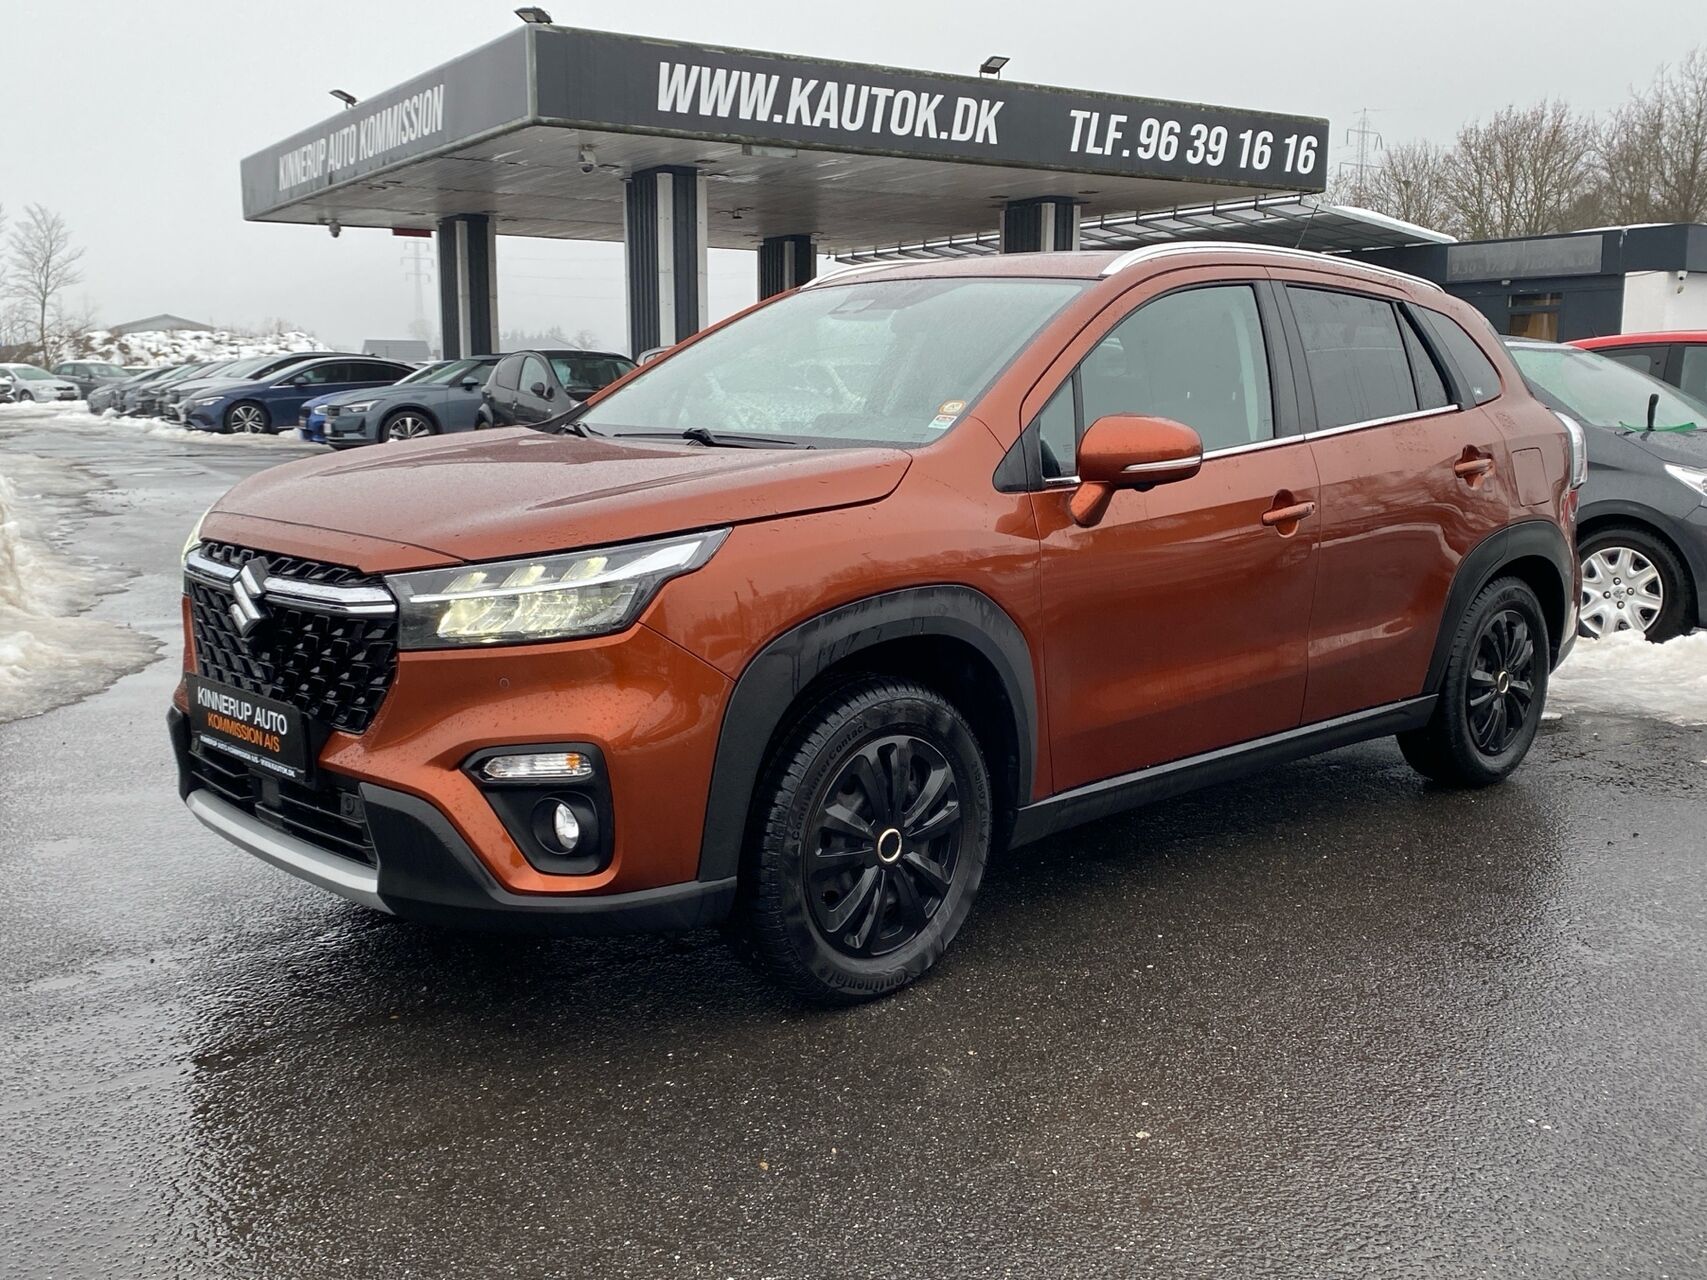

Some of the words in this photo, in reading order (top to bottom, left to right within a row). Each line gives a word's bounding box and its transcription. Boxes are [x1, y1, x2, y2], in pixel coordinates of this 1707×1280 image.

[657, 61, 1004, 145] WWW.KAUTOK.DK
[279, 138, 327, 192] KINNERUP
[327, 124, 357, 173] AUTO
[359, 84, 445, 161] KOMMISSION
[1069, 109, 1131, 158] TLF.
[1137, 118, 1182, 161] 96
[1186, 123, 1229, 167] 39
[1239, 129, 1274, 171] 16
[1284, 134, 1318, 175] 16
[197, 686, 252, 721] KINNERUP
[254, 706, 288, 735] AUTO
[207, 712, 263, 748] KOMMISSION
[263, 733, 280, 752] A/S
